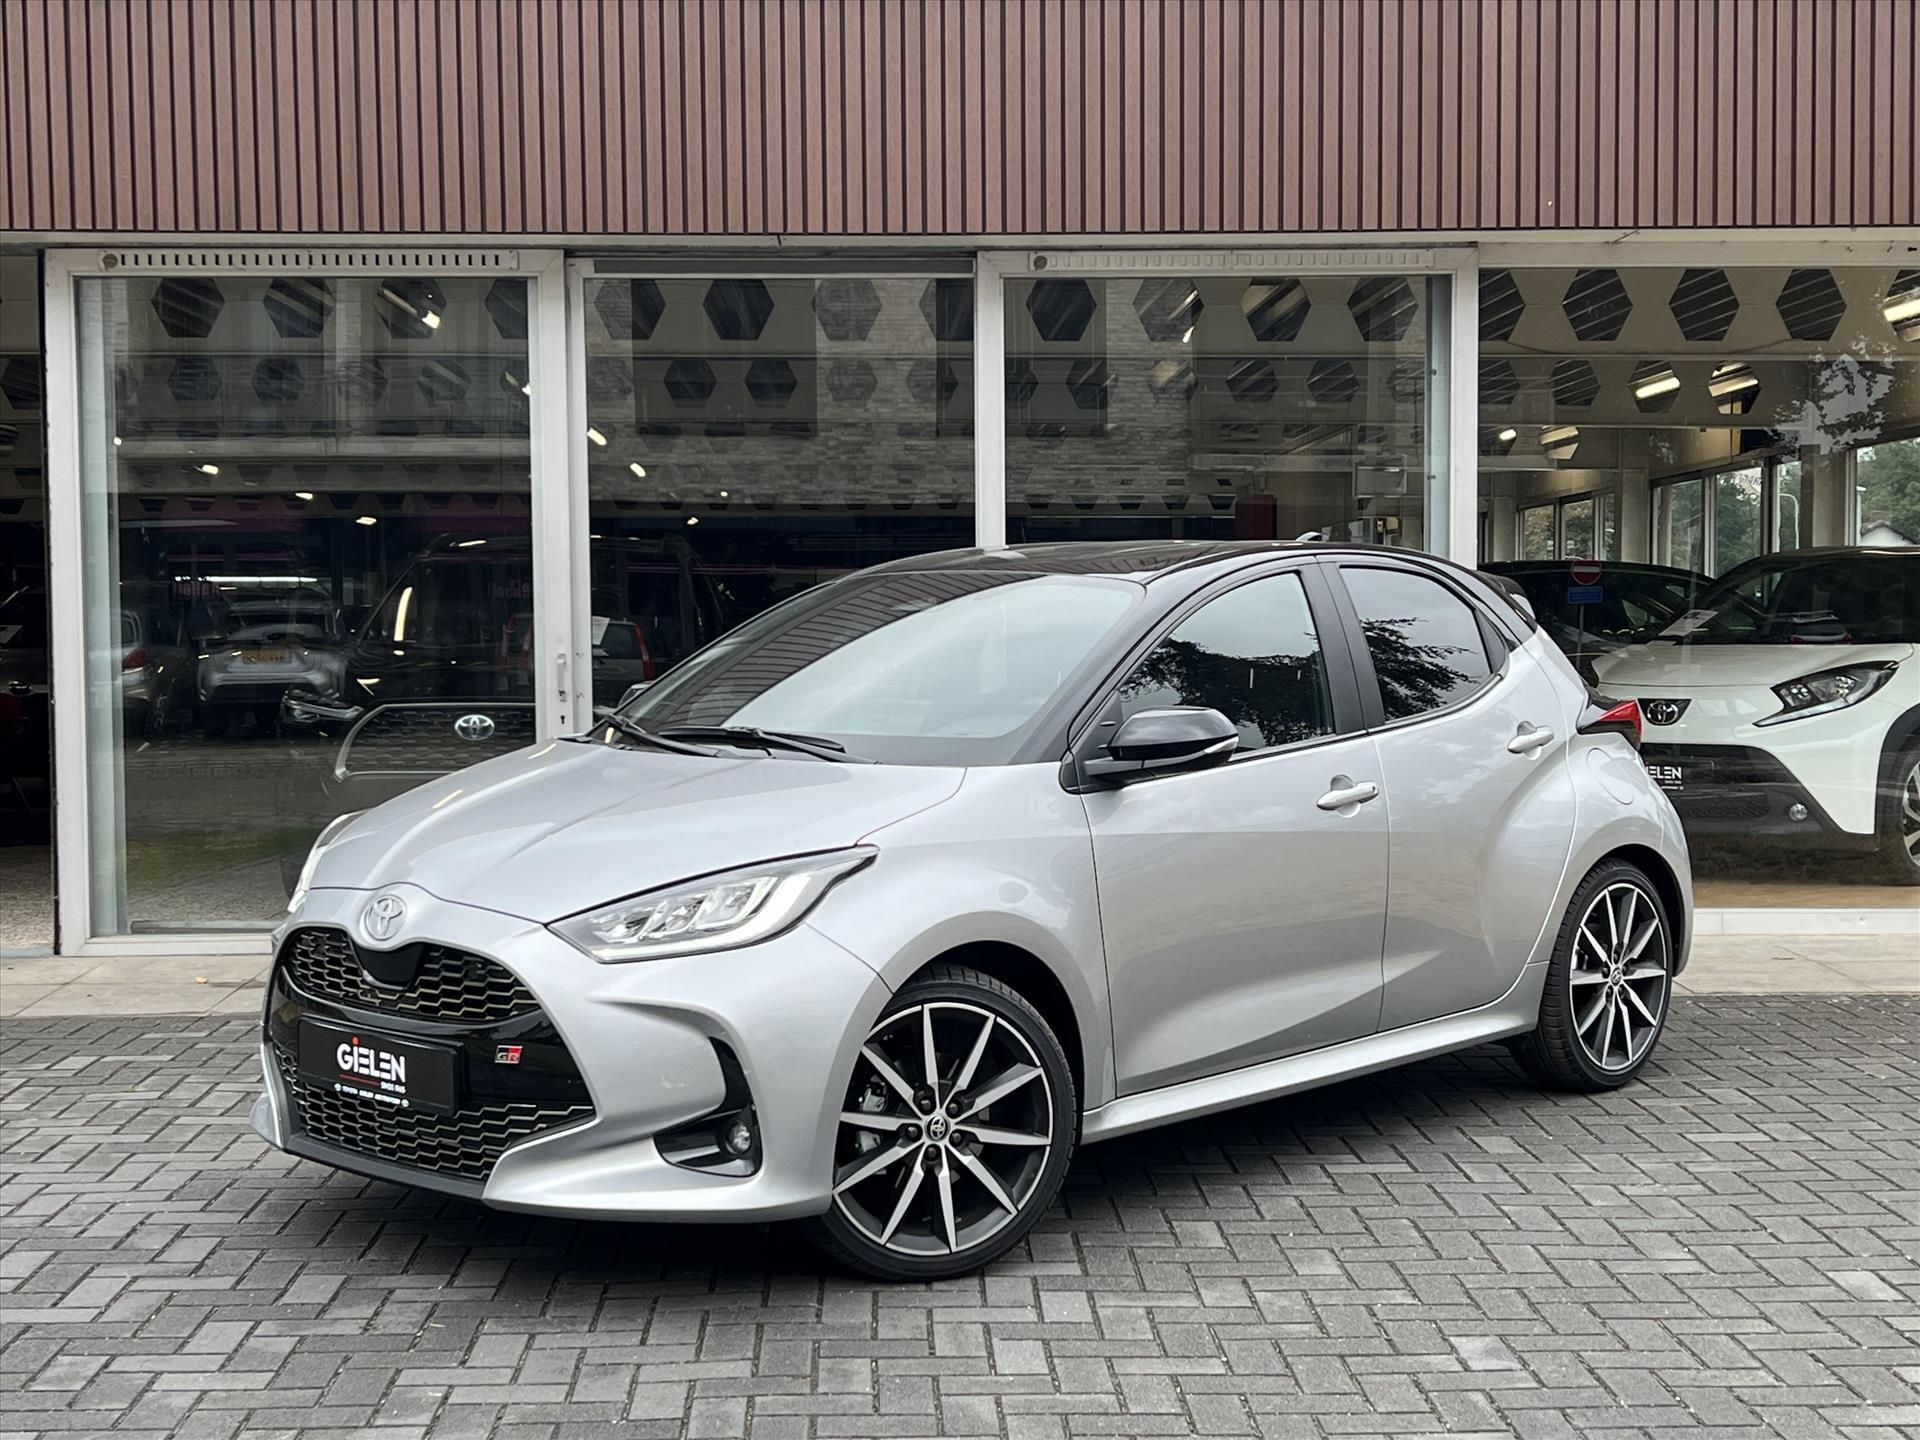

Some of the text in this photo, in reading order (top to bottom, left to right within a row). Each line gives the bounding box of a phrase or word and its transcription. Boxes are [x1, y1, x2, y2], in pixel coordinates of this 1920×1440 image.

[1645, 763, 1682, 779] IELEN
[337, 1036, 406, 1083] GIELEN
[495, 1049, 521, 1064] GR
